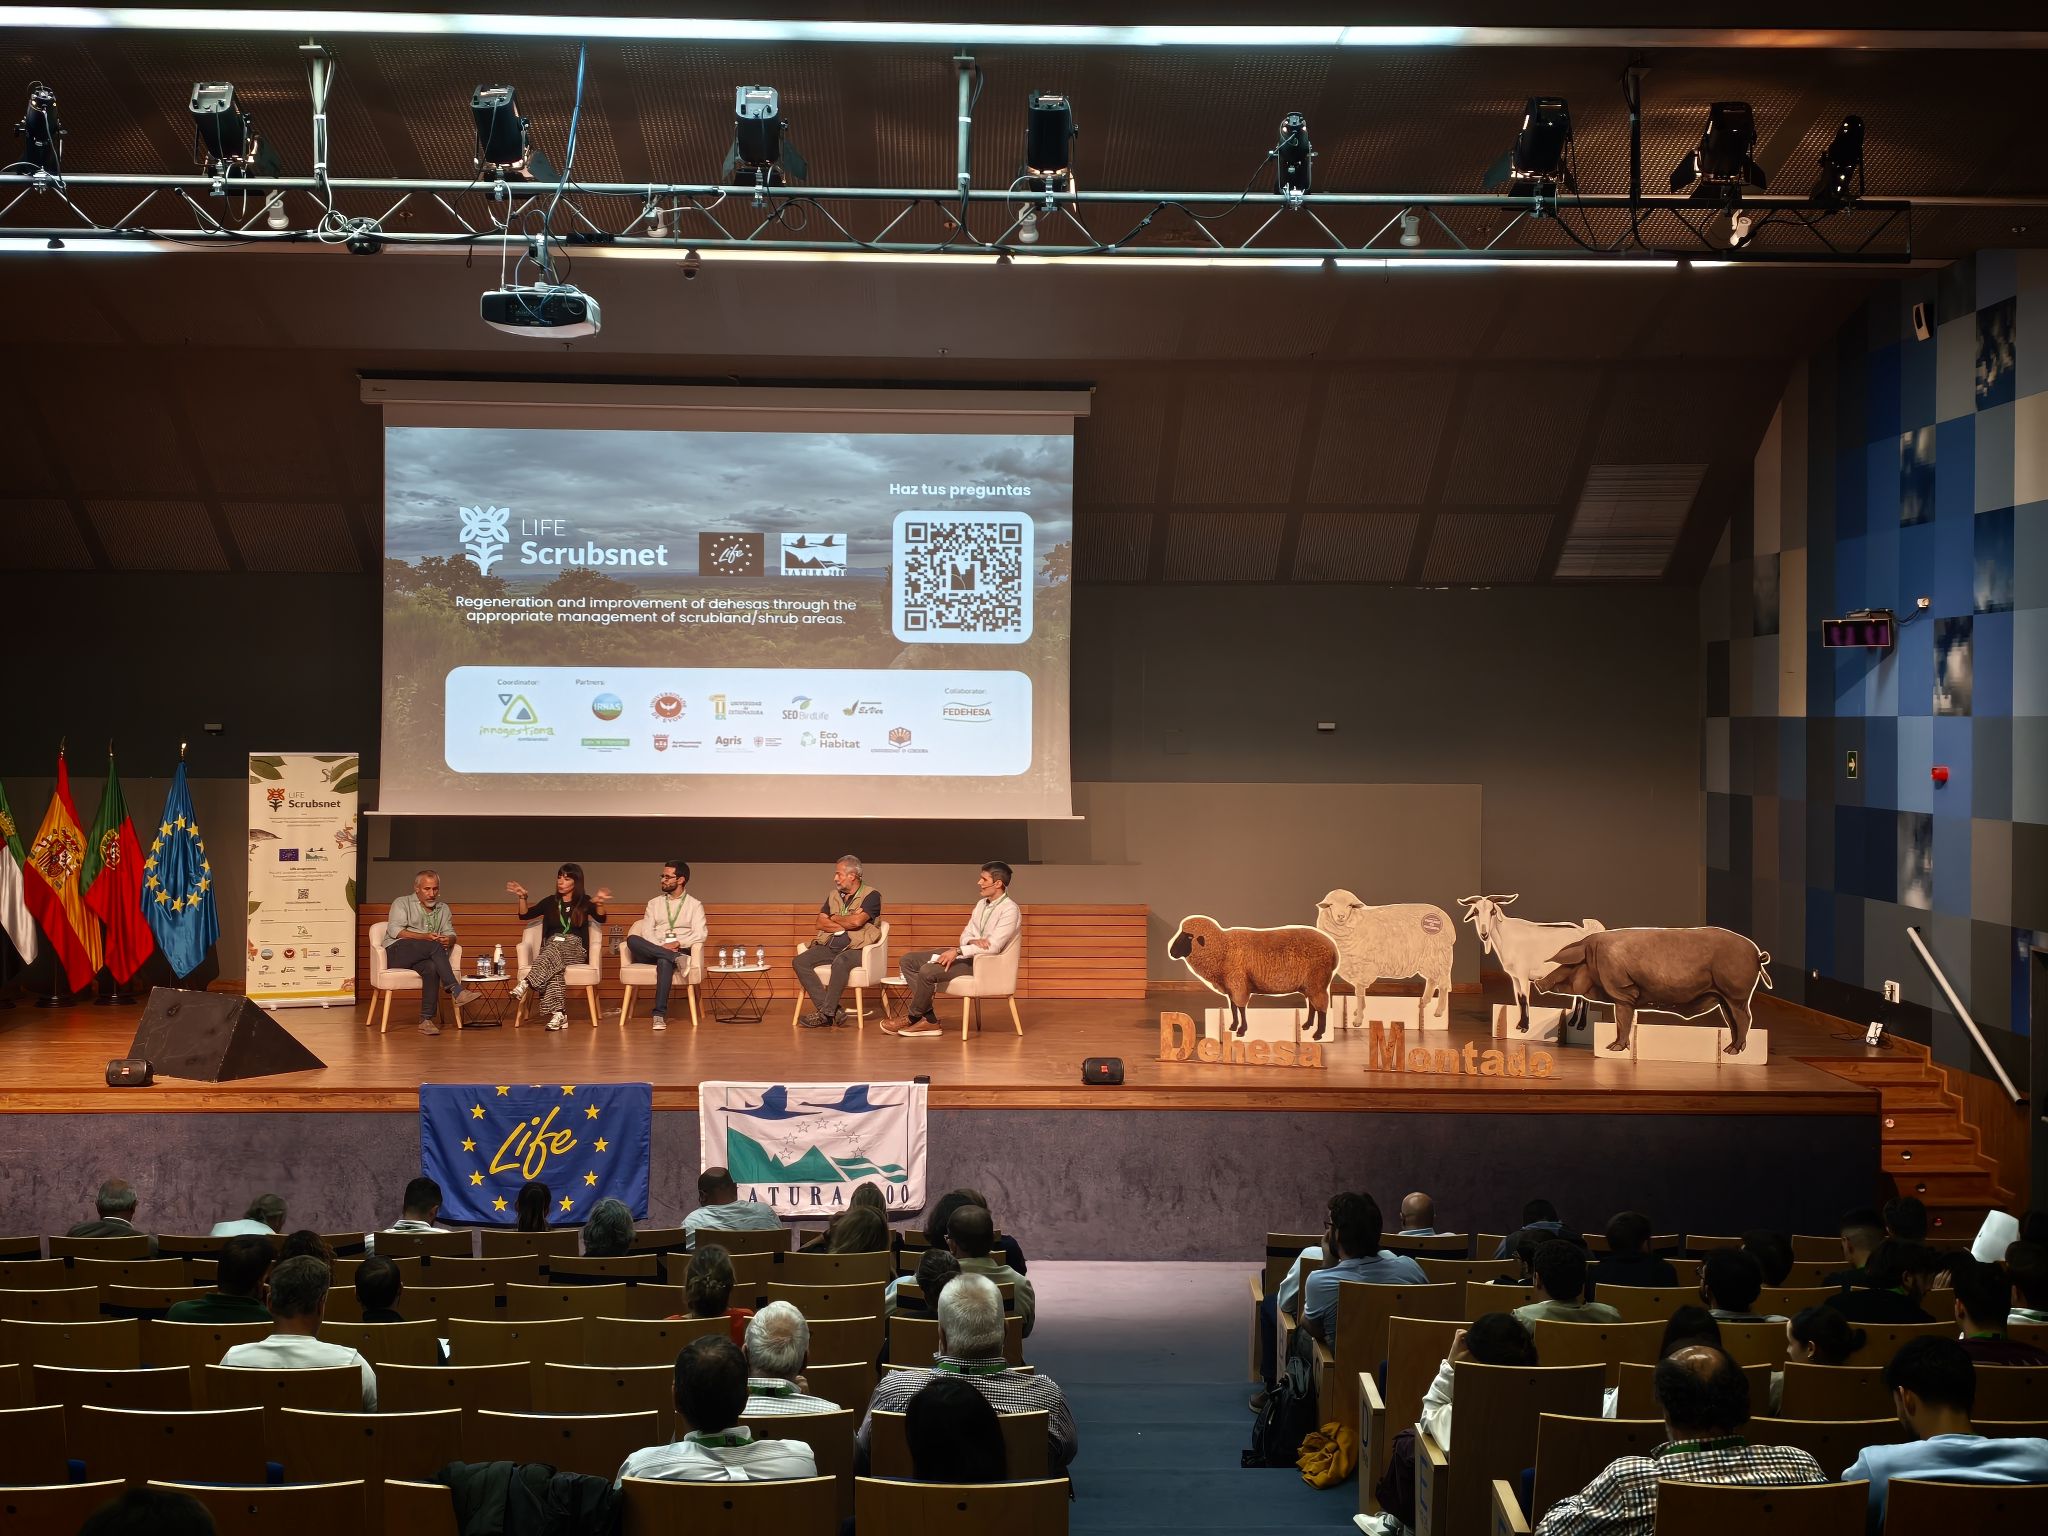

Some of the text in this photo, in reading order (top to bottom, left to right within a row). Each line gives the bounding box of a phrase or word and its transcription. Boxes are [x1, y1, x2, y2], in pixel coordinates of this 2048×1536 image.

[889, 483, 1032, 499] Haz tus preguntas
[521, 519, 566, 537] LIFE
[520, 540, 669, 566] Scrubsnet
[455, 596, 857, 614] Regeneration and improvement of dehesas through the
[466, 610, 846, 626] appropriate management of scrubland/shrub areas.
[782, 709, 799, 720] SEO
[943, 708, 991, 716] FEDEHESA
[715, 736, 742, 747] Agris
[819, 730, 839, 740] Eco
[819, 739, 861, 749] Habitat
[288, 791, 305, 799] LIFE
[288, 799, 341, 808] Scrubsnet
[1160, 1011, 1323, 1067] Dehesa
[1368, 1020, 1555, 1077] Montado
[488, 1105, 578, 1180] Life
[736, 1185, 844, 1207] ATURA
